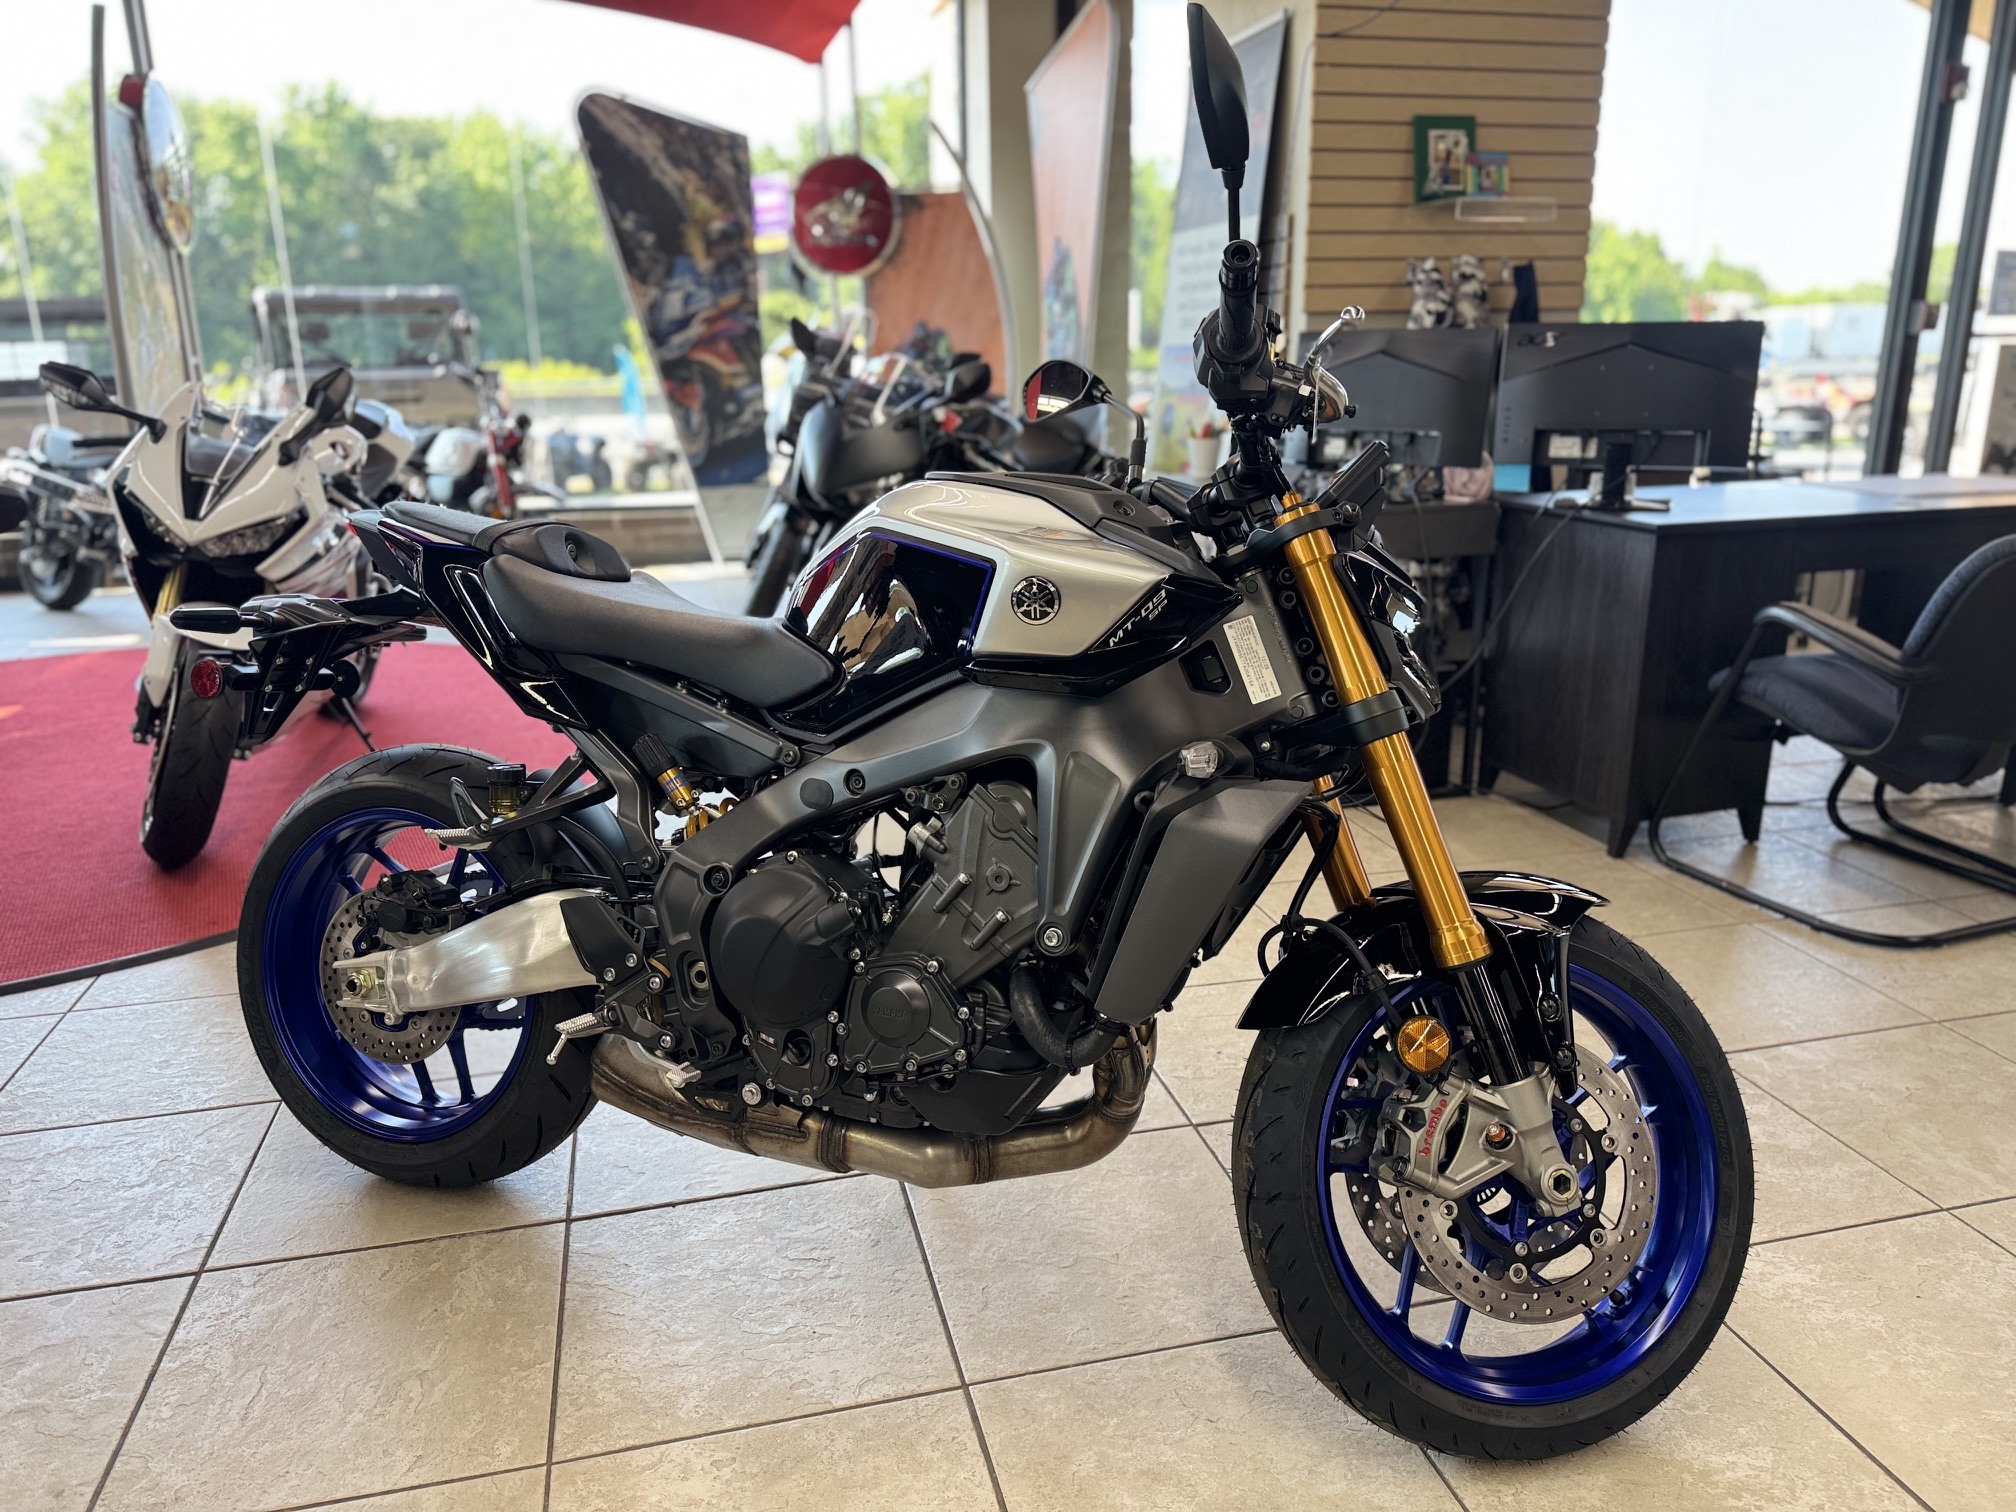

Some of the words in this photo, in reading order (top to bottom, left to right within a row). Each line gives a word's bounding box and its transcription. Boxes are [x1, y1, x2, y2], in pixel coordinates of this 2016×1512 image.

[1109, 588, 1167, 647] MT-09
[1148, 598, 1168, 621] SP
[872, 1005, 907, 1019] YAMAHA
[1418, 1098, 1448, 1157] brembo
